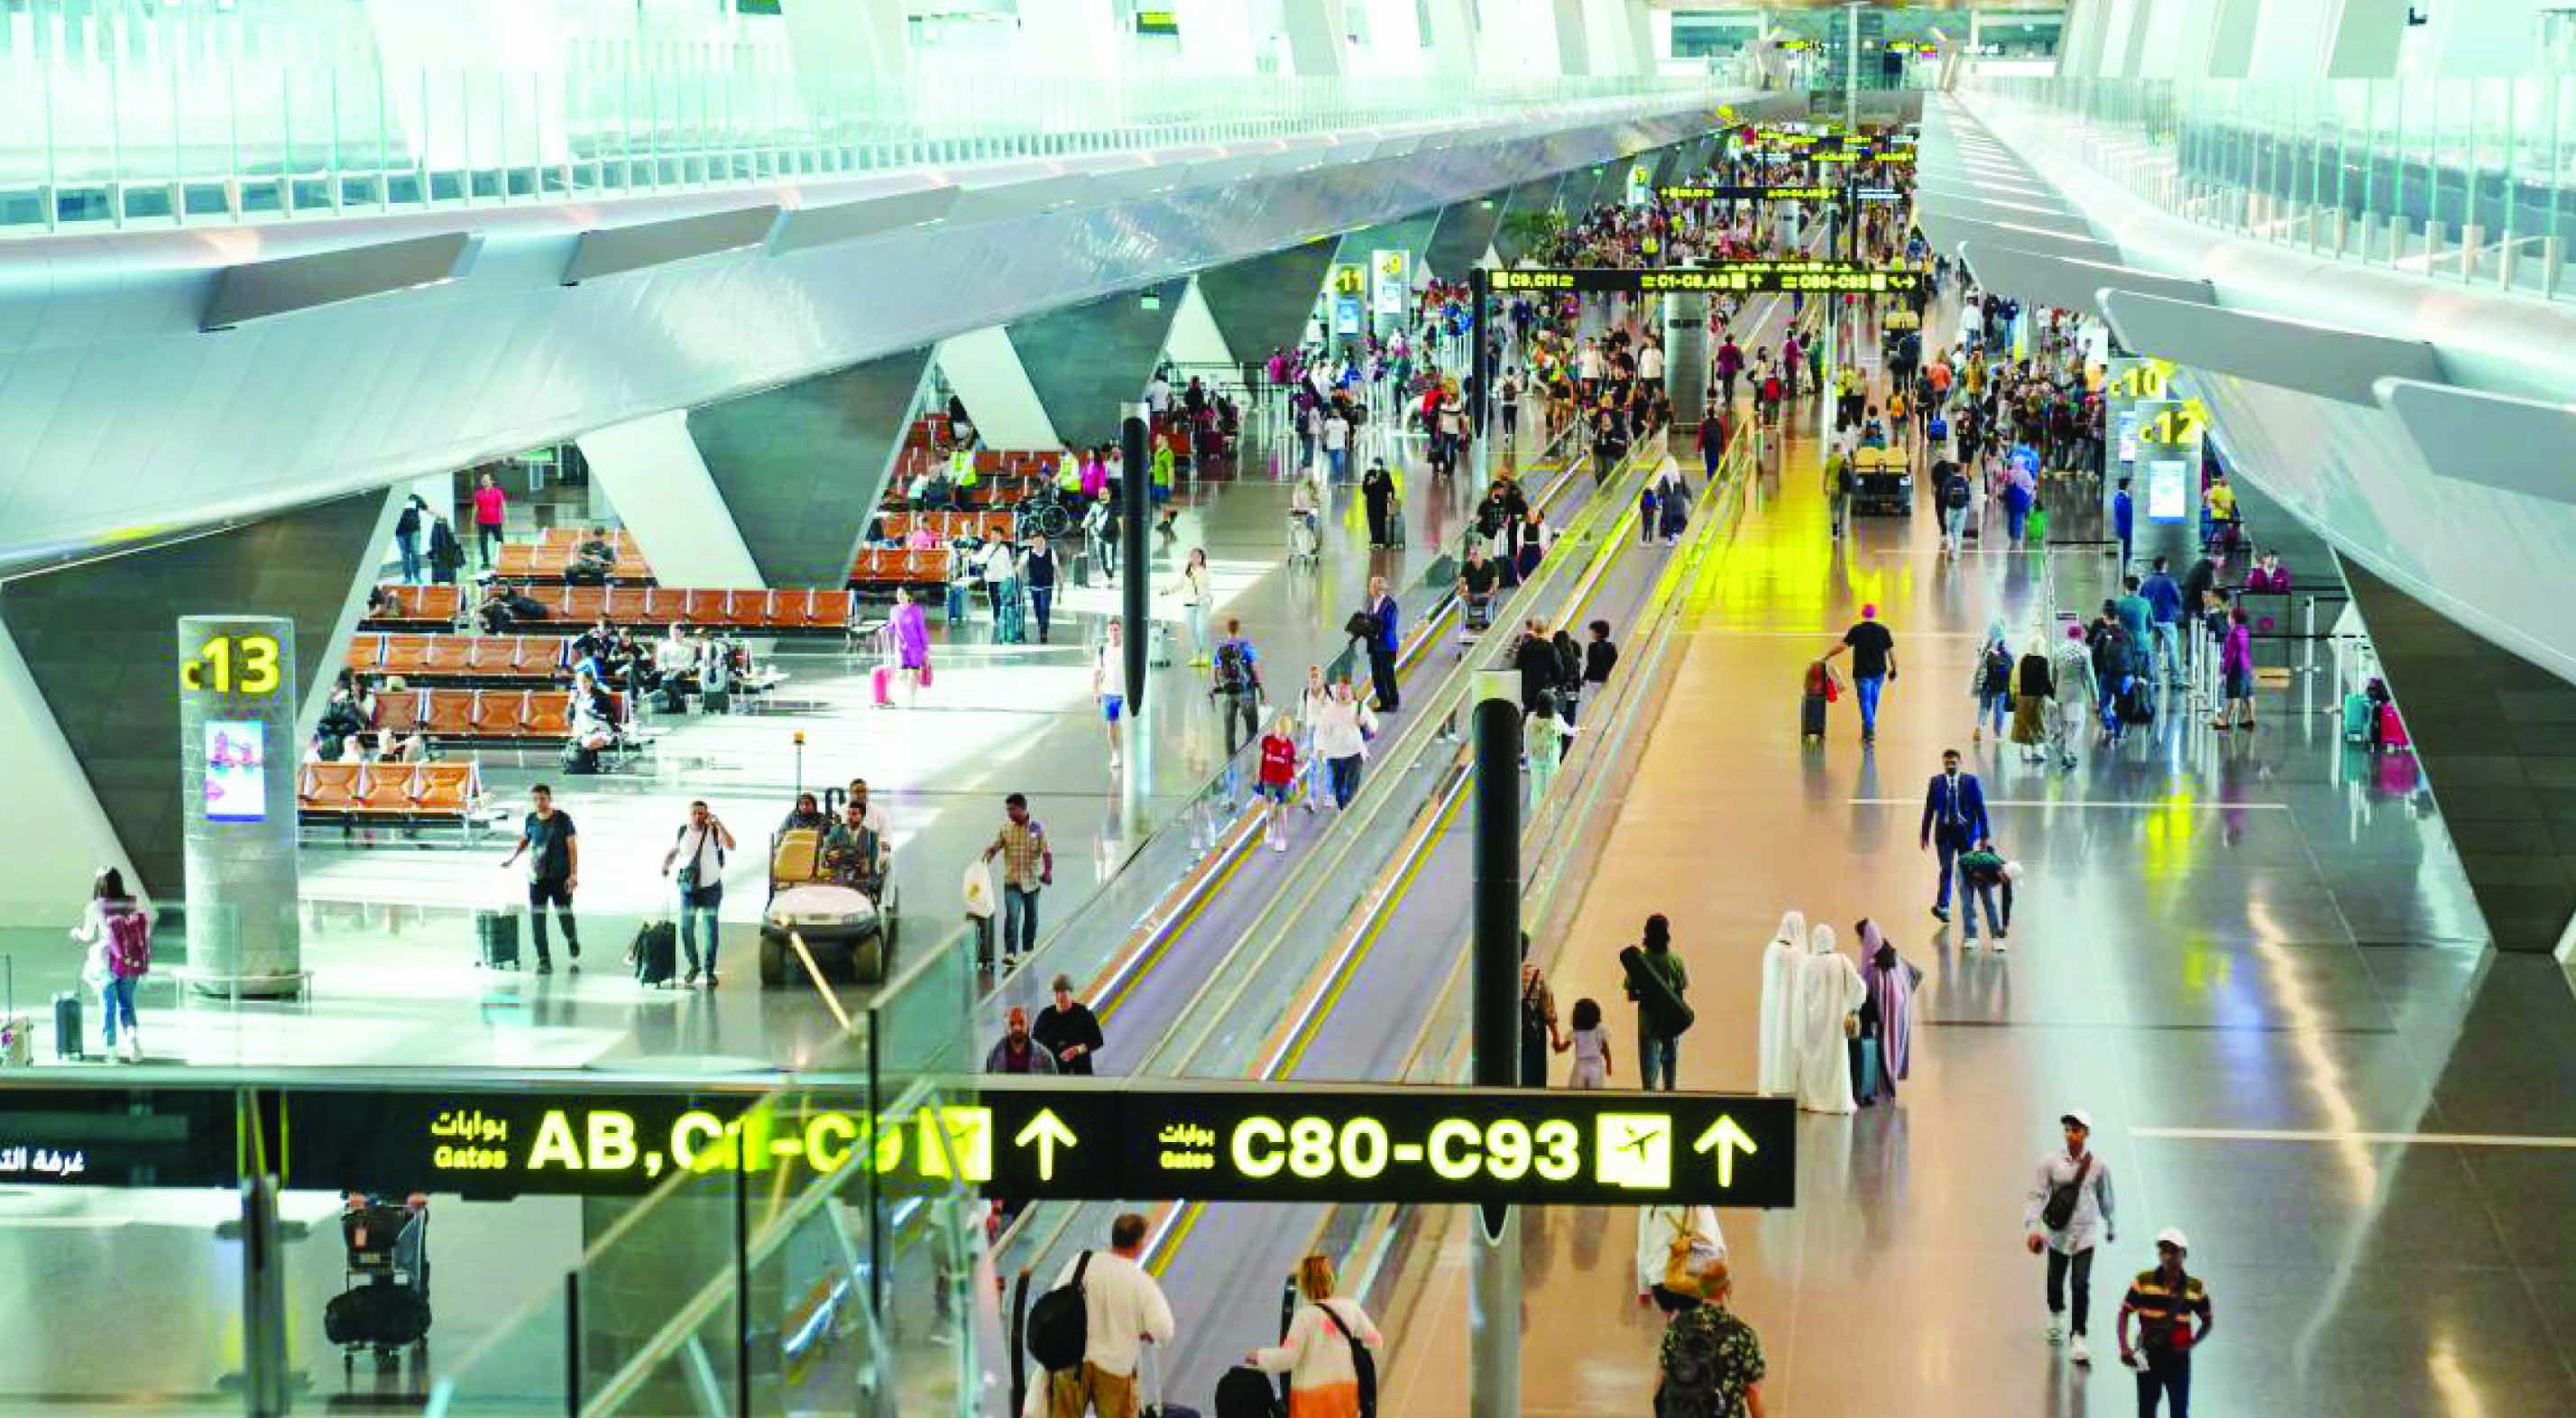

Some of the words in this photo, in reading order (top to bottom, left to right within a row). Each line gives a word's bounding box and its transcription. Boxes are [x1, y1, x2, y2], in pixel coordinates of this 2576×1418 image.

[433, 1145, 507, 1169] Gates
[1158, 1150, 1215, 1169] Gates
[1230, 1115, 1580, 1180] C80-C93
